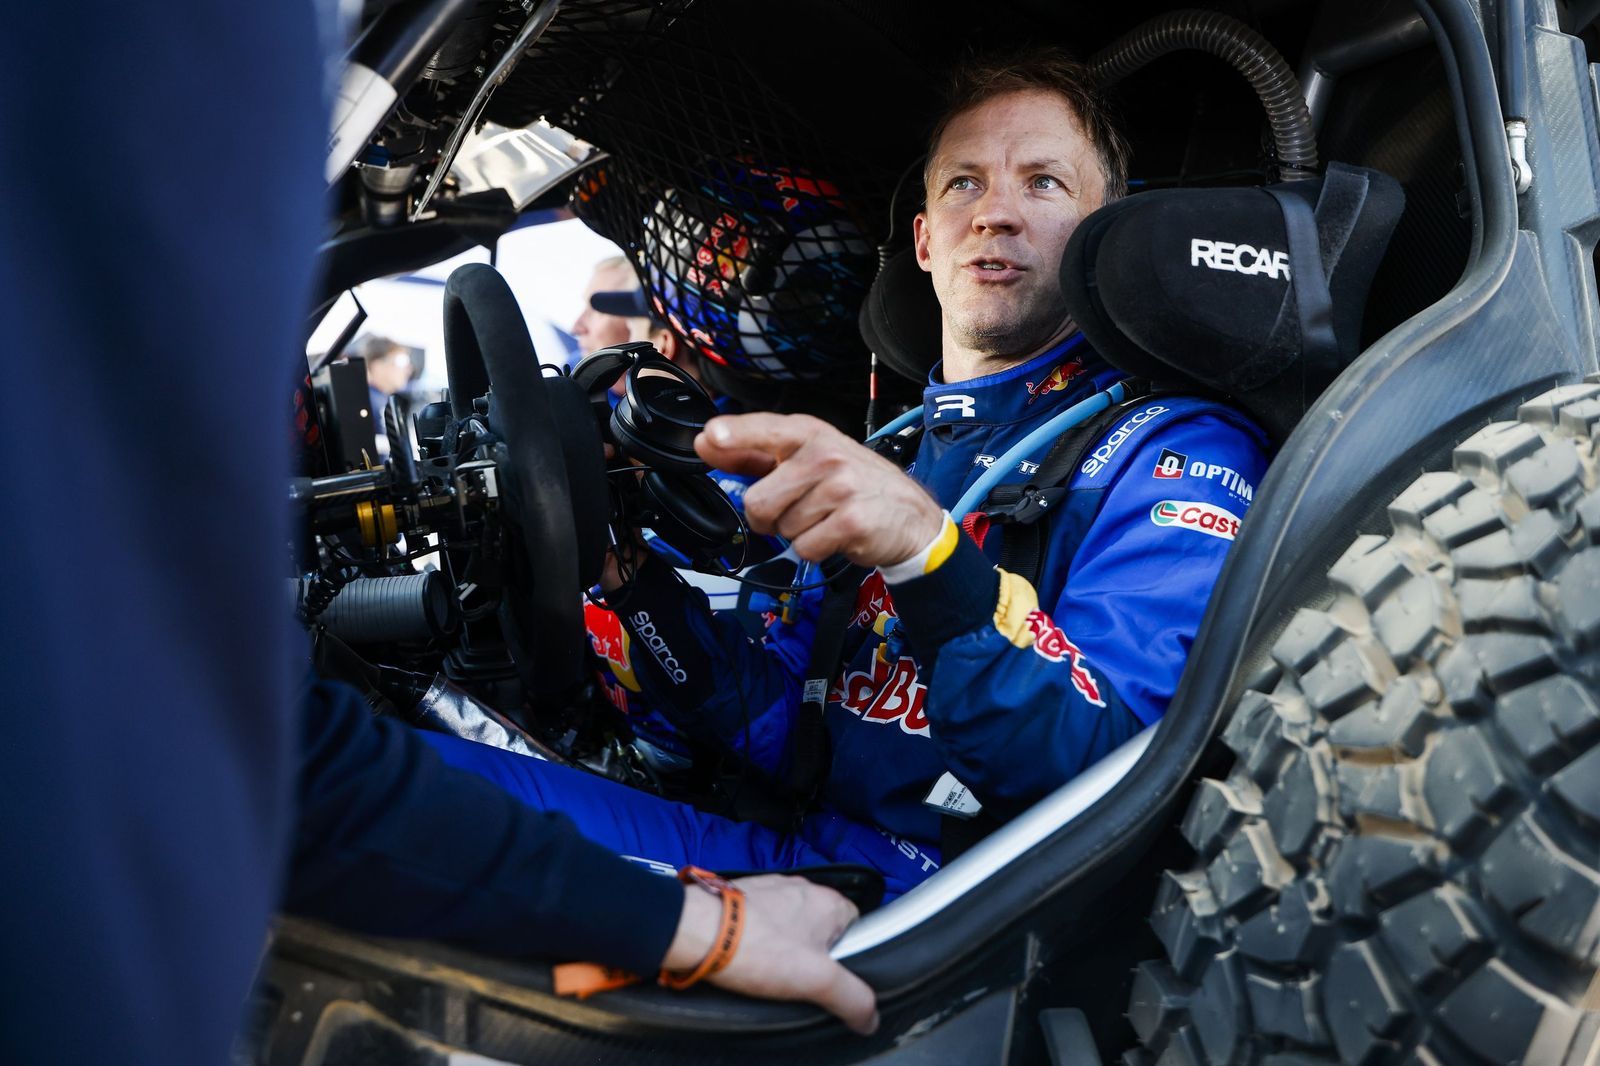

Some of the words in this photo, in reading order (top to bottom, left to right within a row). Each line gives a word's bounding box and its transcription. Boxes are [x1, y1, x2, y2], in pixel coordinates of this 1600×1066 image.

[1081, 406, 1170, 478] sparco
[1189, 461, 1253, 501] OPTIM
[1180, 507, 1240, 537] Cast
[629, 611, 687, 685] sparco
